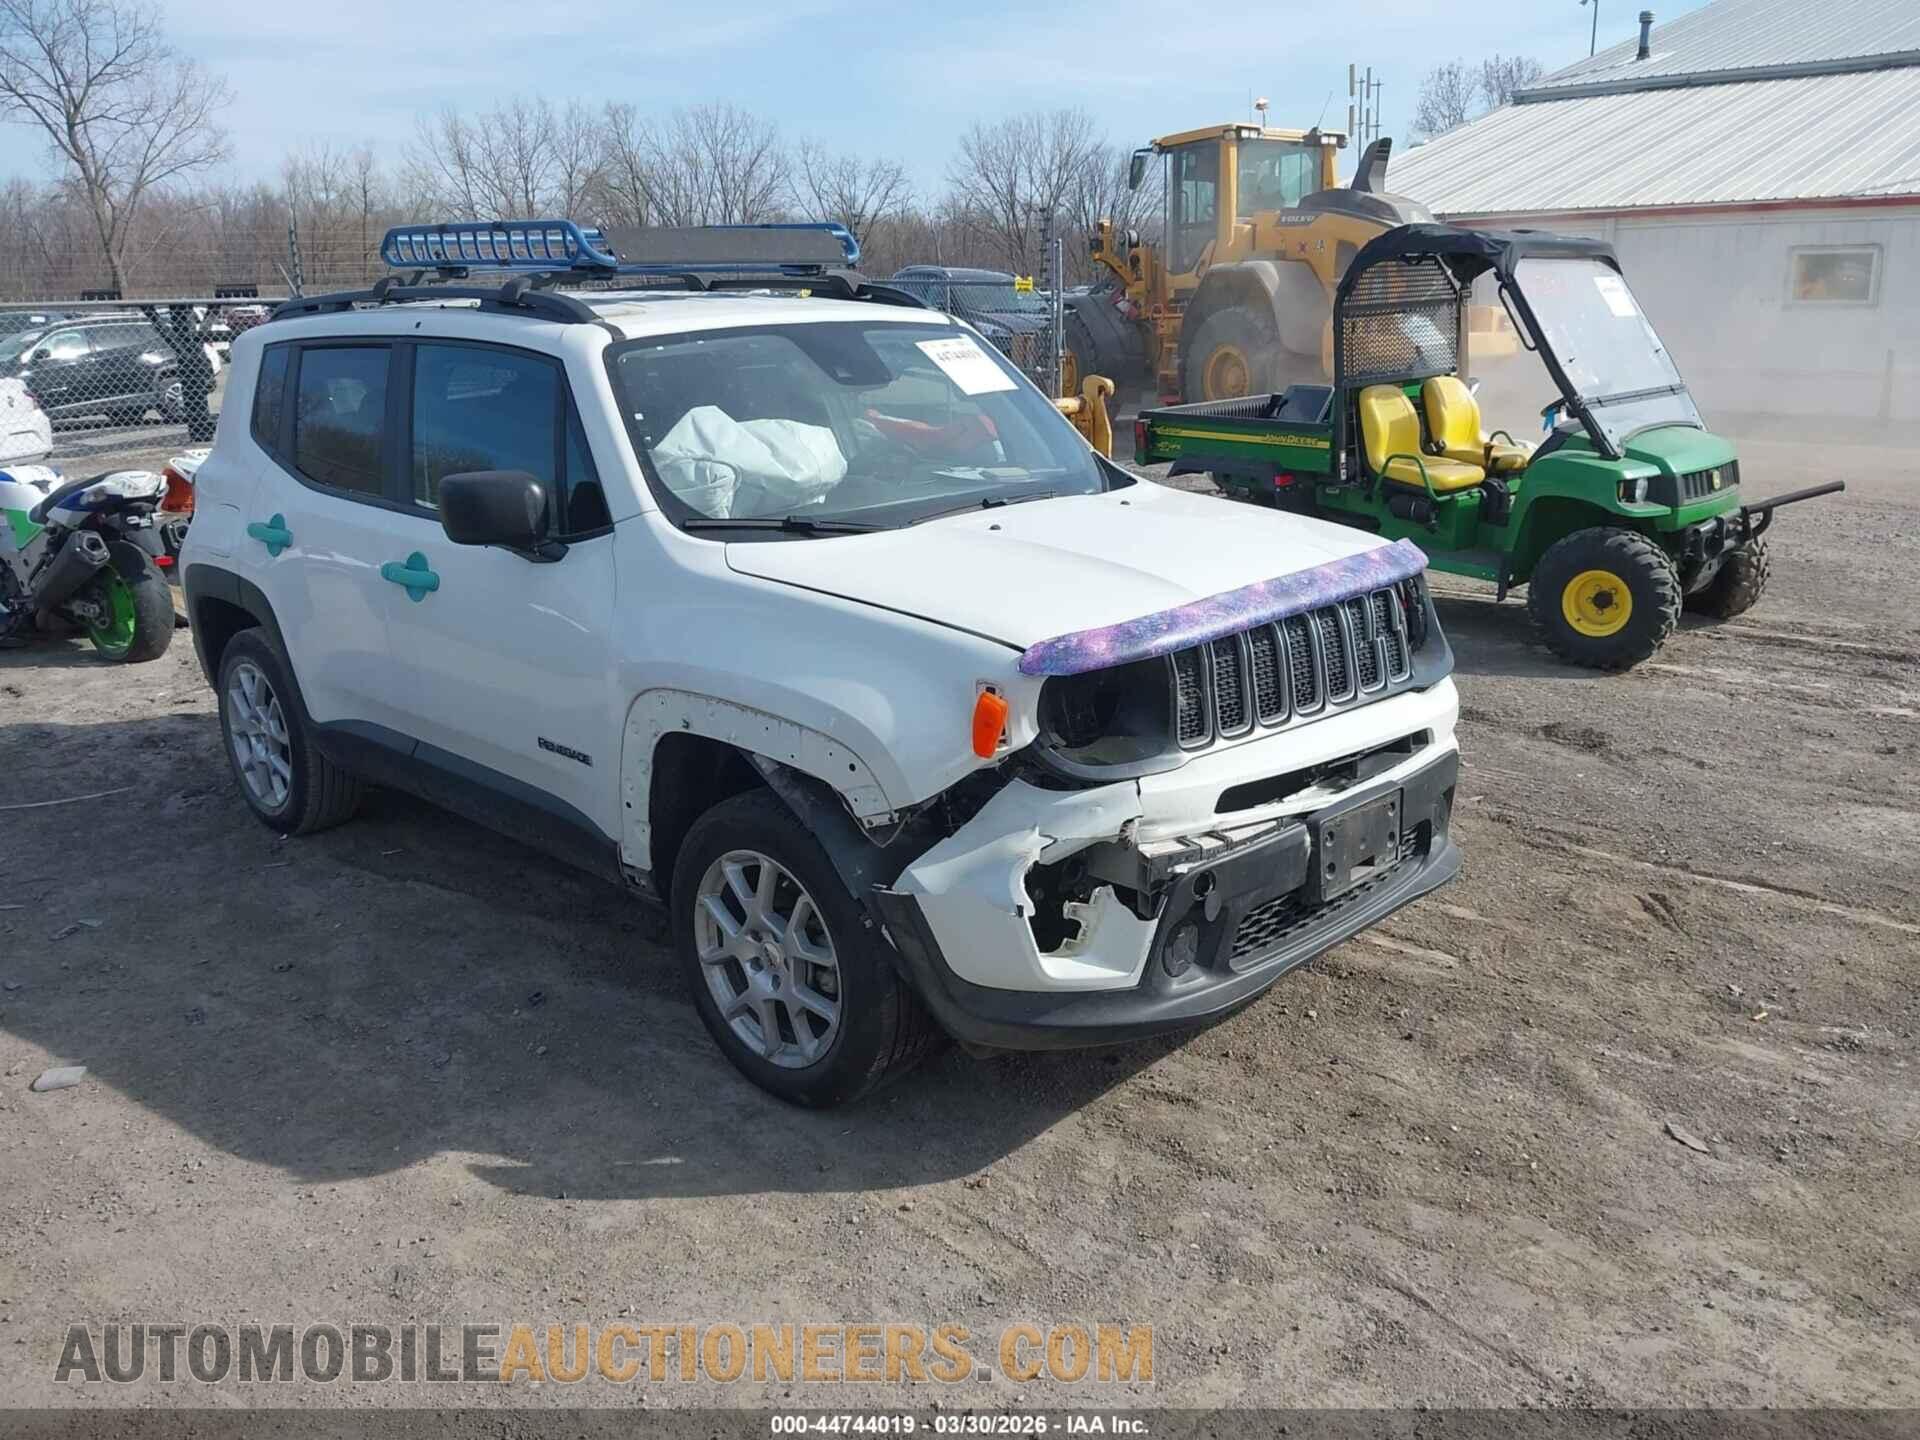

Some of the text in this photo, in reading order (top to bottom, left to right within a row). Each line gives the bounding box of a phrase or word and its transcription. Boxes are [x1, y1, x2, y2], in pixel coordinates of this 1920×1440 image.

[1281, 215, 1314, 223] VOLVO
[1264, 434, 1320, 447] JOHN DEERE
